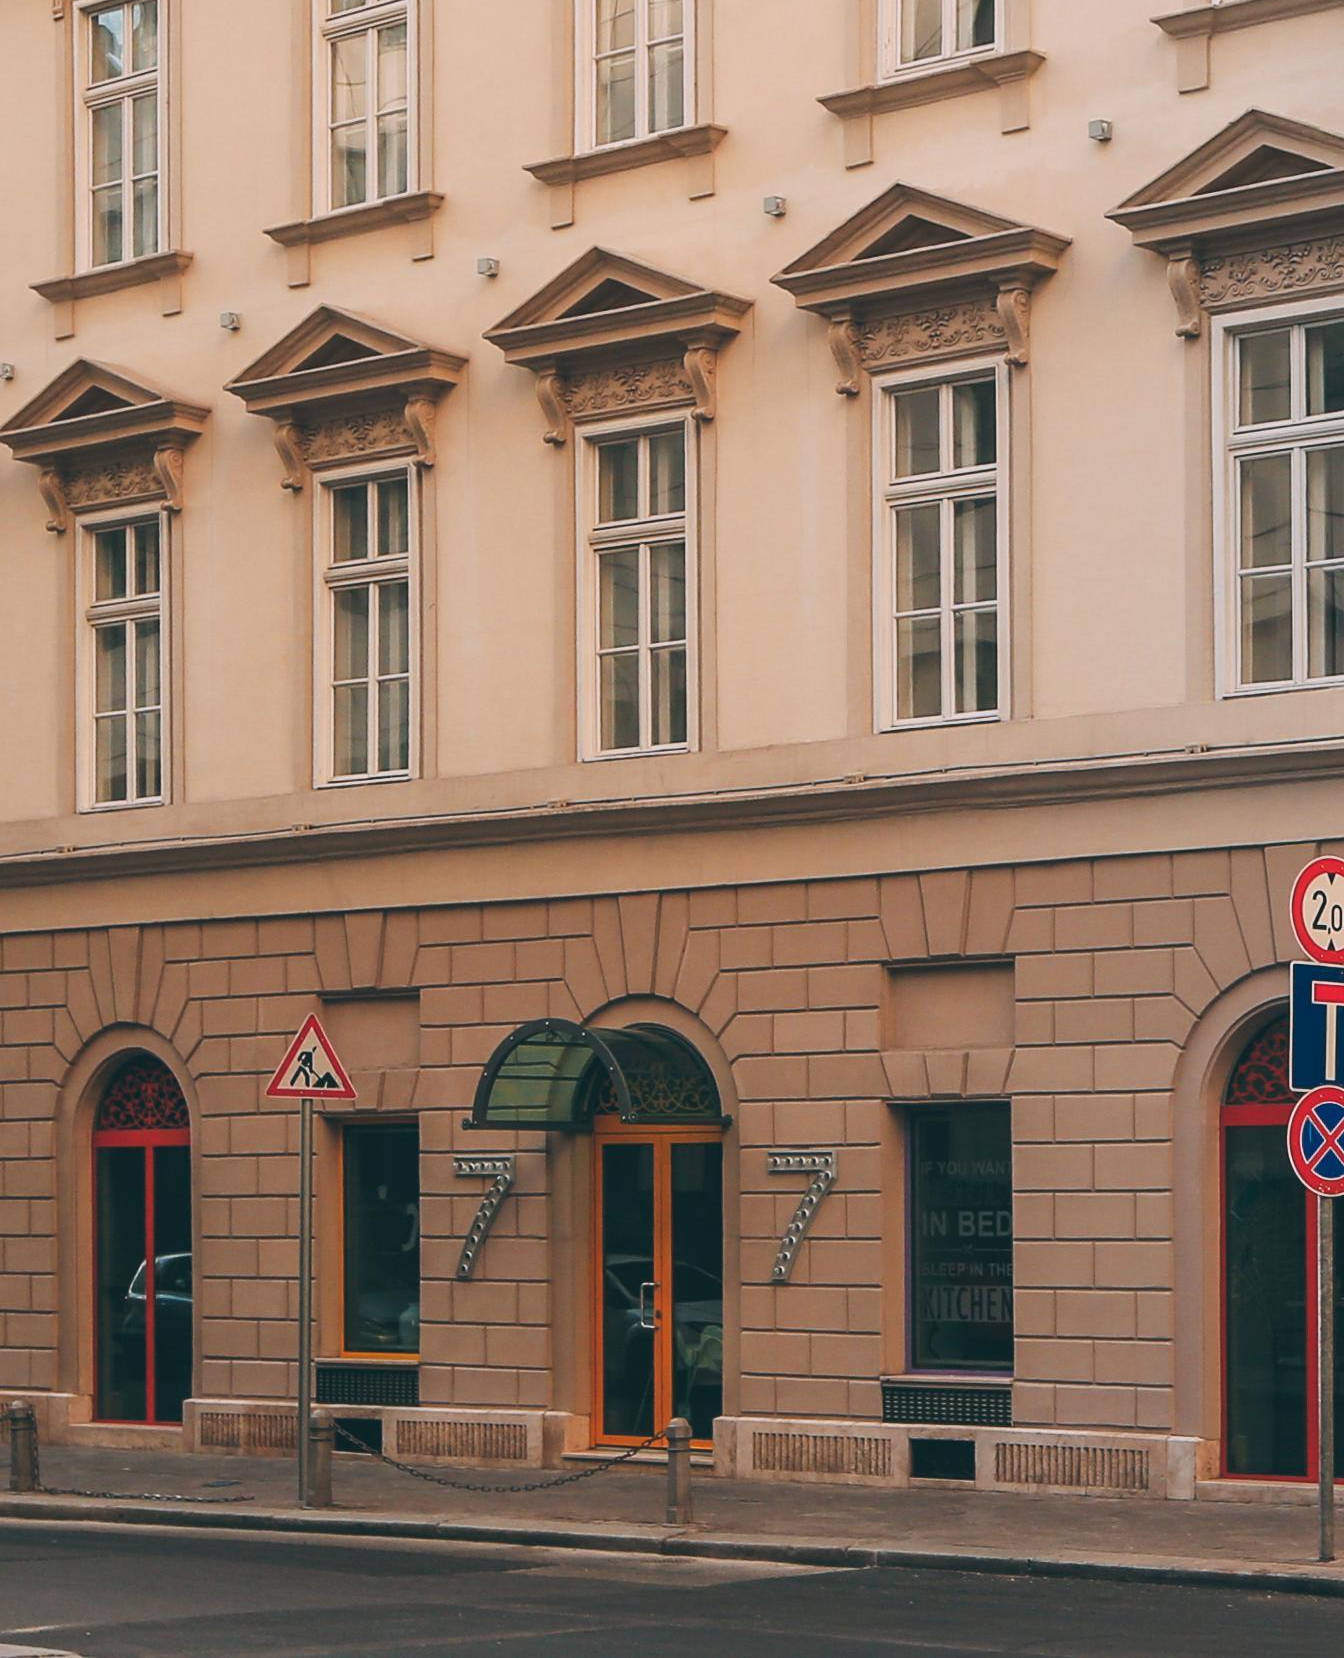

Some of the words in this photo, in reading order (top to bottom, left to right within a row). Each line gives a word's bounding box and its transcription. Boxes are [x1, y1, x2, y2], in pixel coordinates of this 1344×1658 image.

[937, 1160, 966, 1176] YOU
[453, 1154, 515, 1280] 7
[767, 1150, 838, 1282] 7
[922, 1210, 946, 1237] IN
[958, 1210, 1013, 1237] BED
[922, 1262, 966, 1277] SLEEP
[969, 1262, 984, 1277] IN
[988, 1262, 1013, 1277] THE
